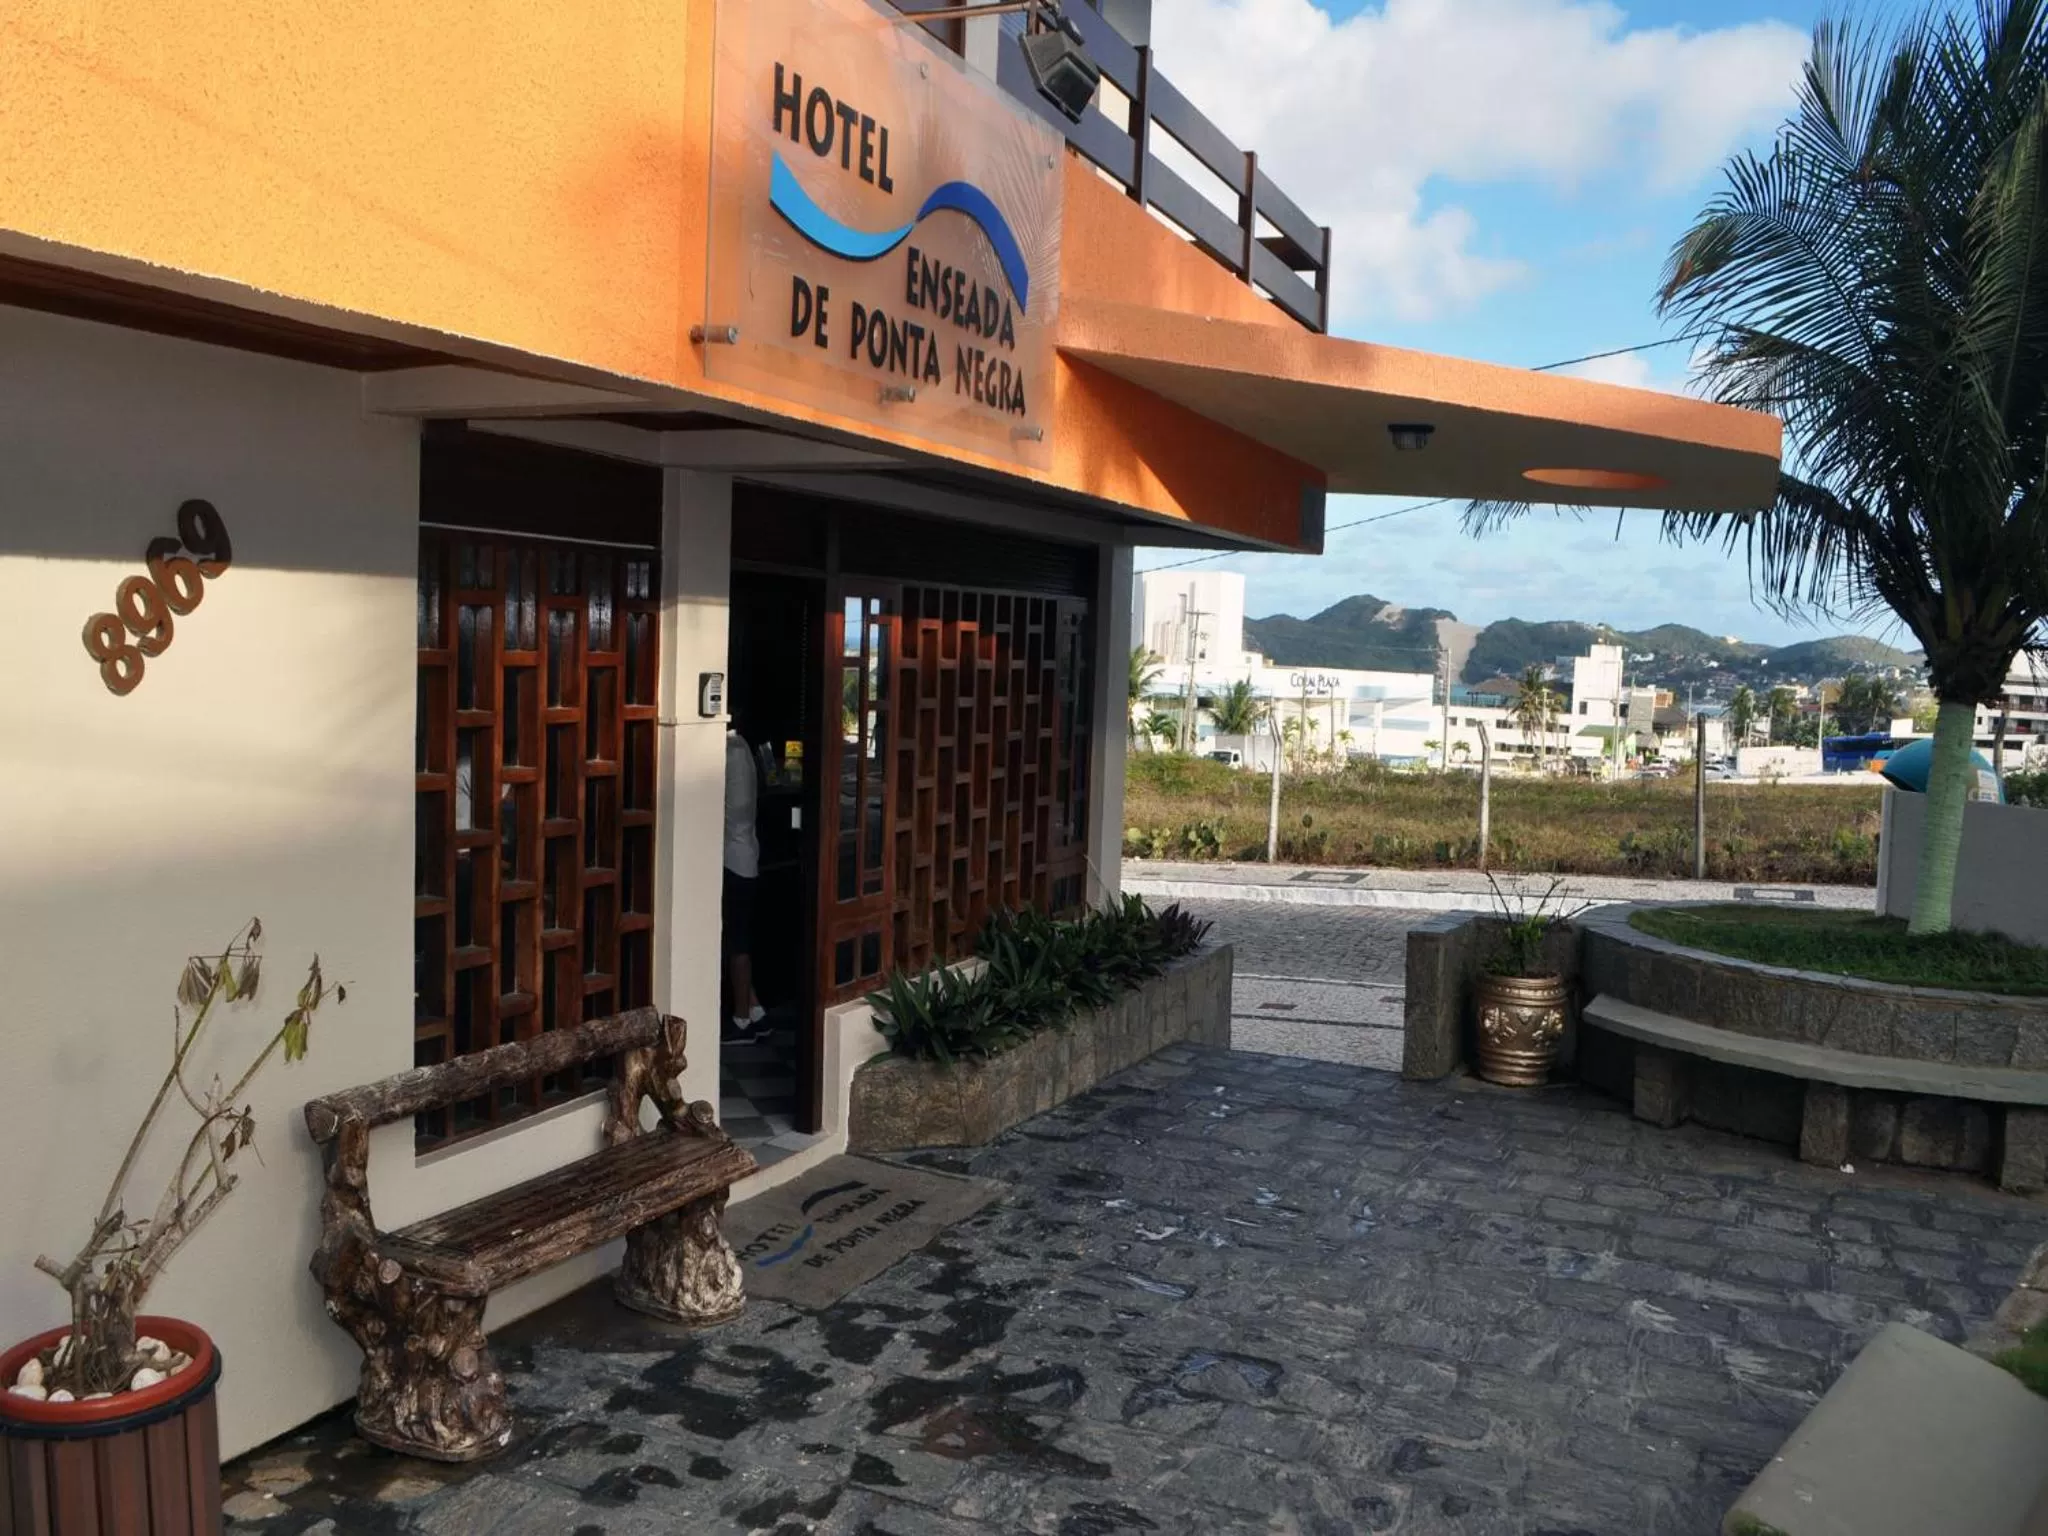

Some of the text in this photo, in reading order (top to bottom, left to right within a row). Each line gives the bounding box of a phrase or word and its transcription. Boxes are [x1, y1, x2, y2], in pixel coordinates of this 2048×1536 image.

[773, 62, 893, 195] HOTEL
[791, 275, 1025, 417] DE PONTA NEGRA
[906, 246, 1015, 351] ENSEADA
[82, 499, 232, 697] 8969
